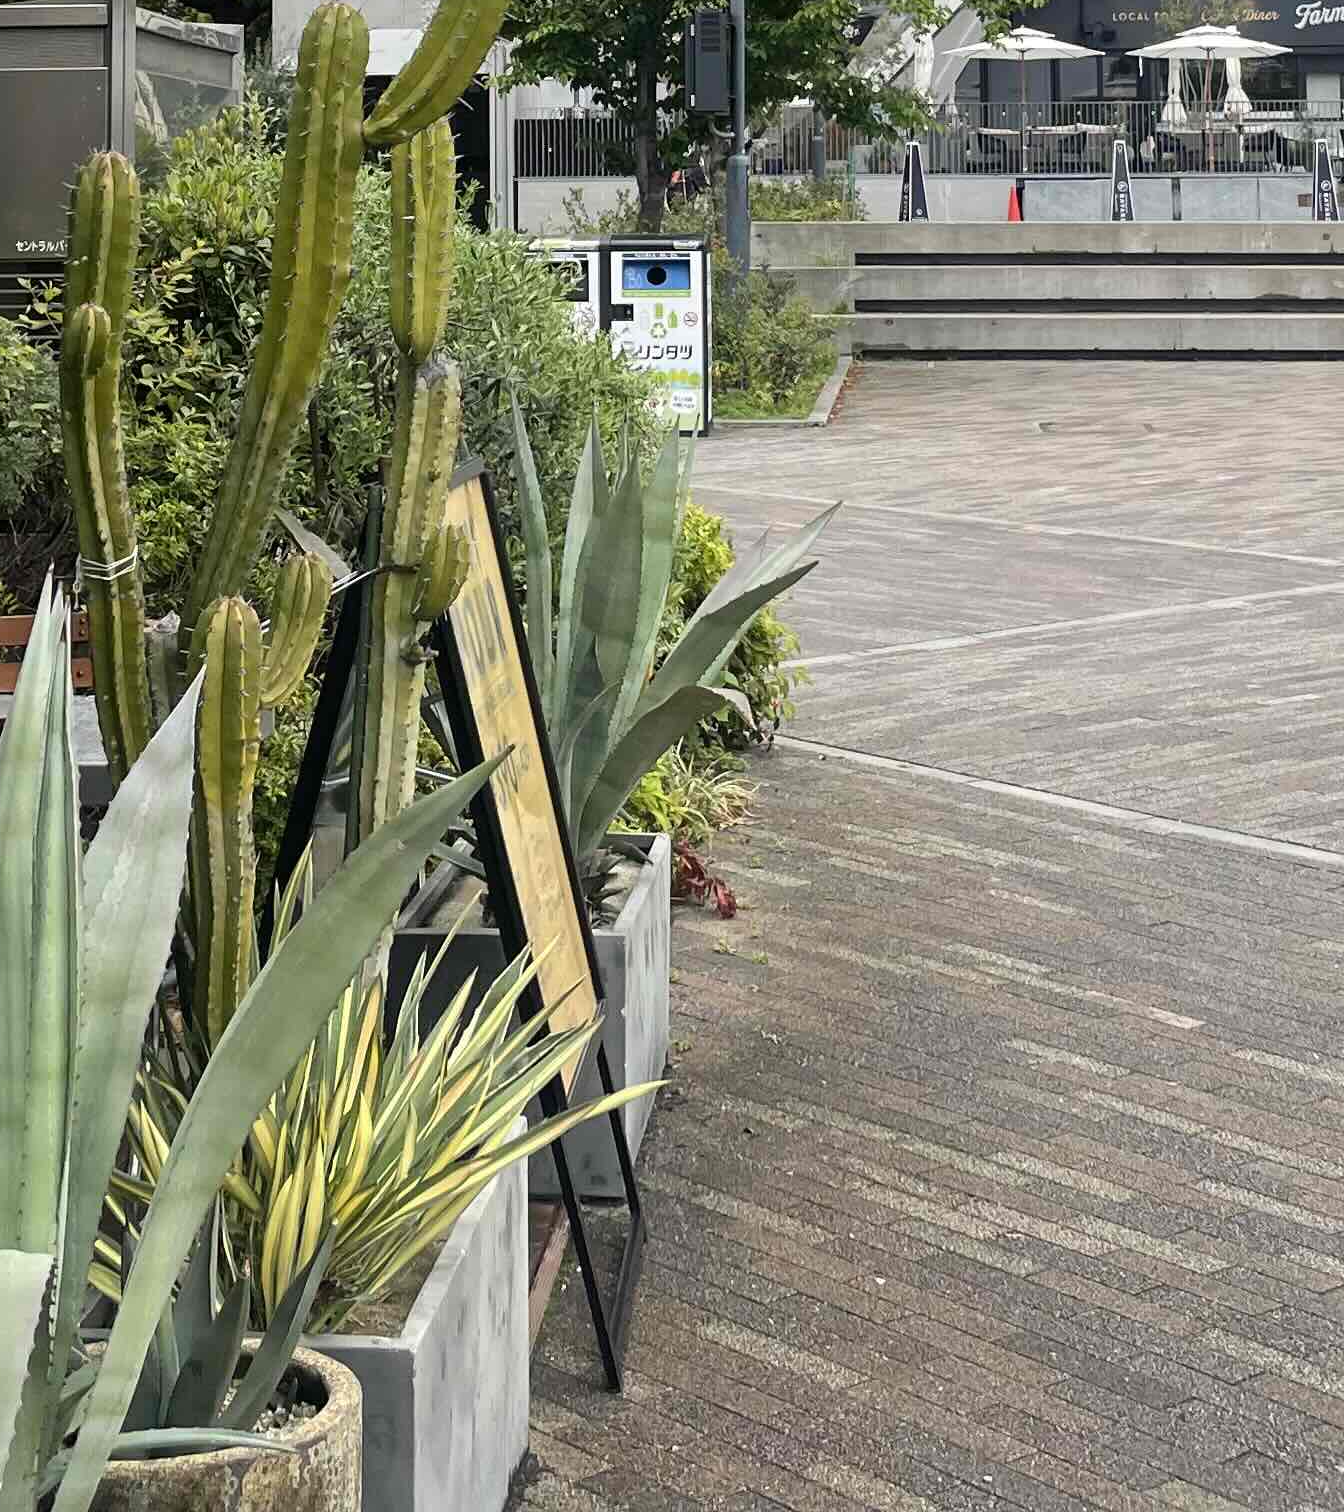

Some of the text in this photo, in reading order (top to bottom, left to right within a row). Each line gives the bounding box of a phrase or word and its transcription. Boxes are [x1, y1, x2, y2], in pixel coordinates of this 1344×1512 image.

[1112, 11, 1151, 22] LOCAL
[16, 240, 68, 252] セントラルパ
